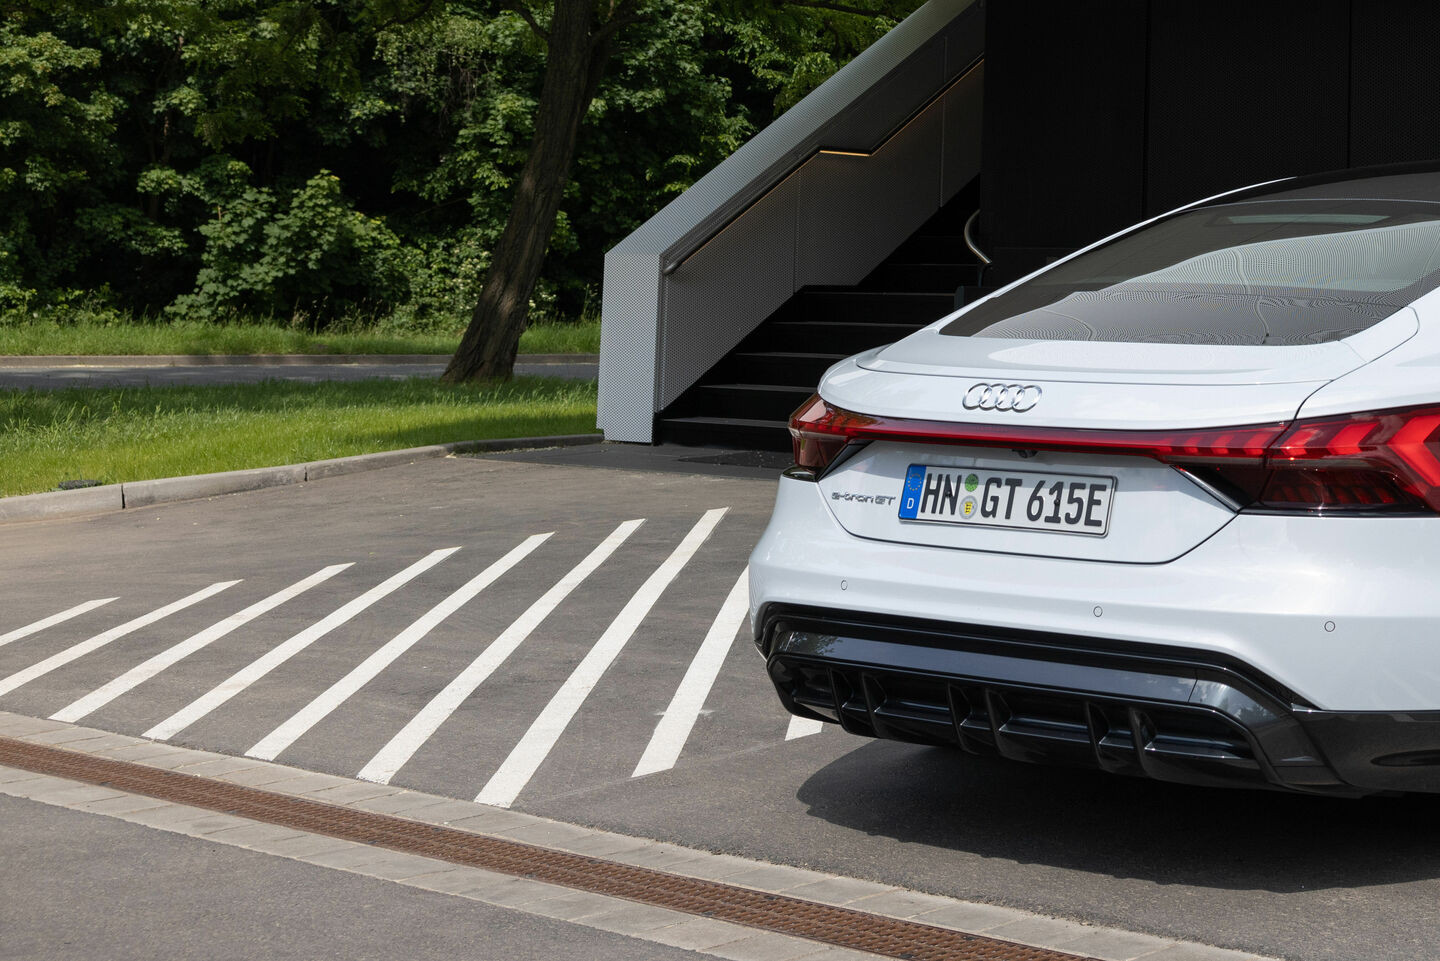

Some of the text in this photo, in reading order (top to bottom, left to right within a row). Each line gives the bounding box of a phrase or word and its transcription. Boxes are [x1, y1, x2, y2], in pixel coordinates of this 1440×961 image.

[906, 497, 915, 510] D
[920, 473, 1108, 527] HN GT 615E
